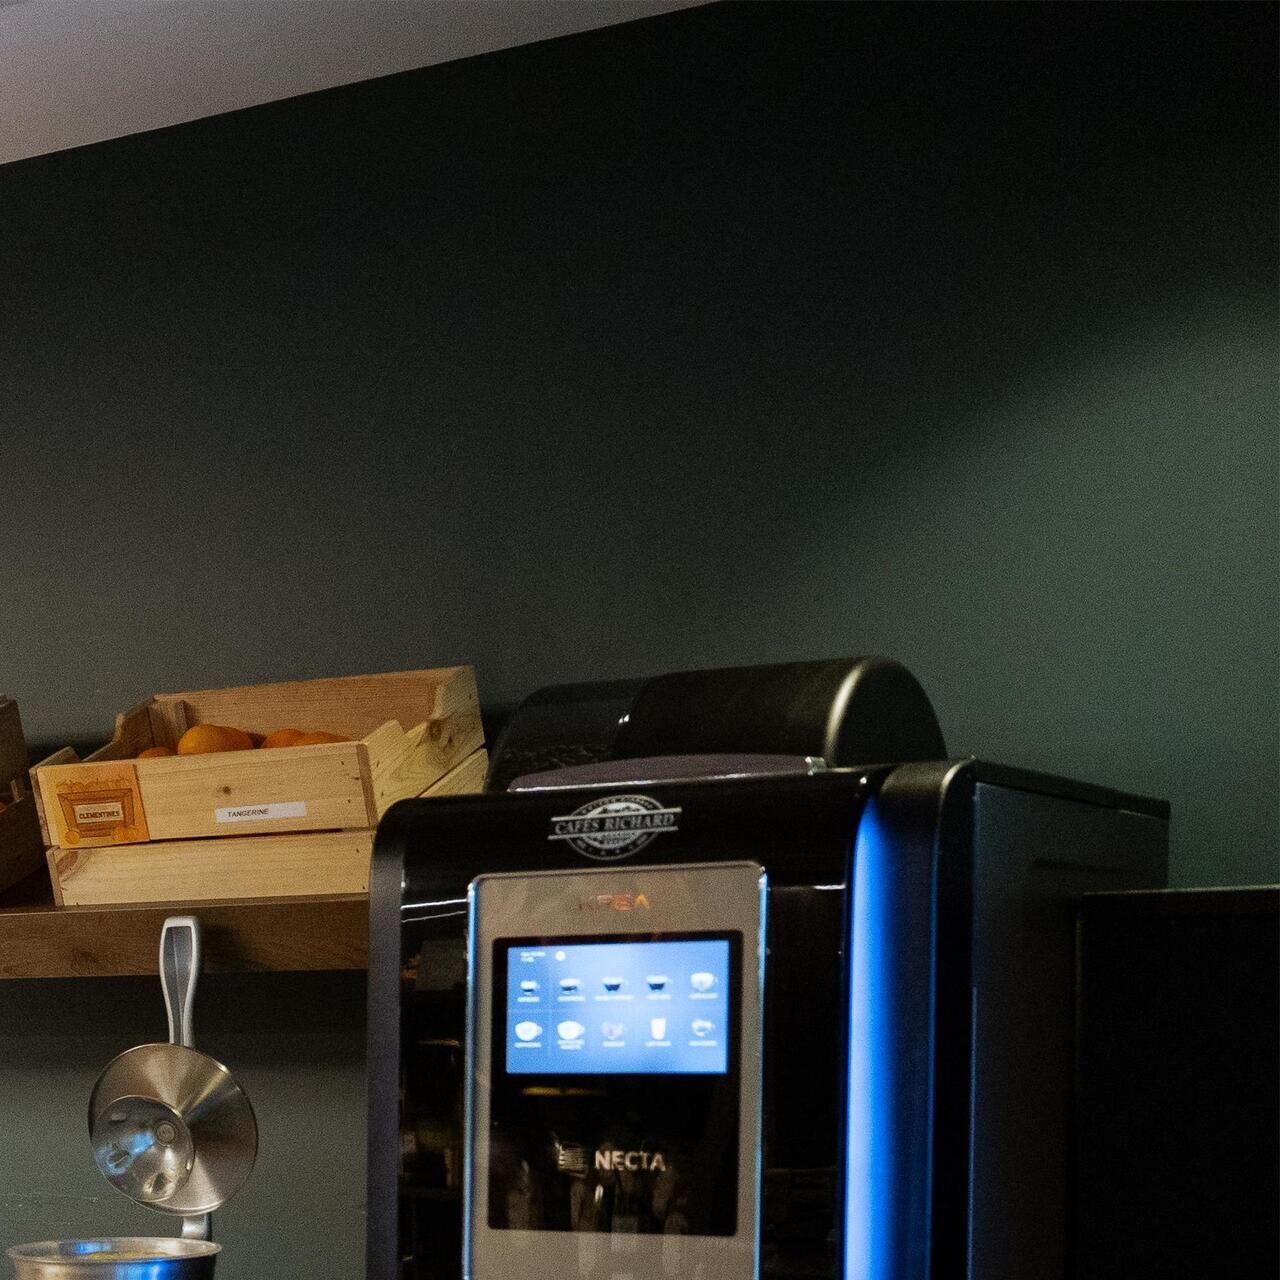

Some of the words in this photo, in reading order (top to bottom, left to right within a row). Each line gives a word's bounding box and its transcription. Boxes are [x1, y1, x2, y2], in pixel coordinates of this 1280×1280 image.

[227, 808, 269, 818] TANGERINE
[604, 814, 675, 830] RICHARD
[595, 1150, 666, 1171] NECTA
